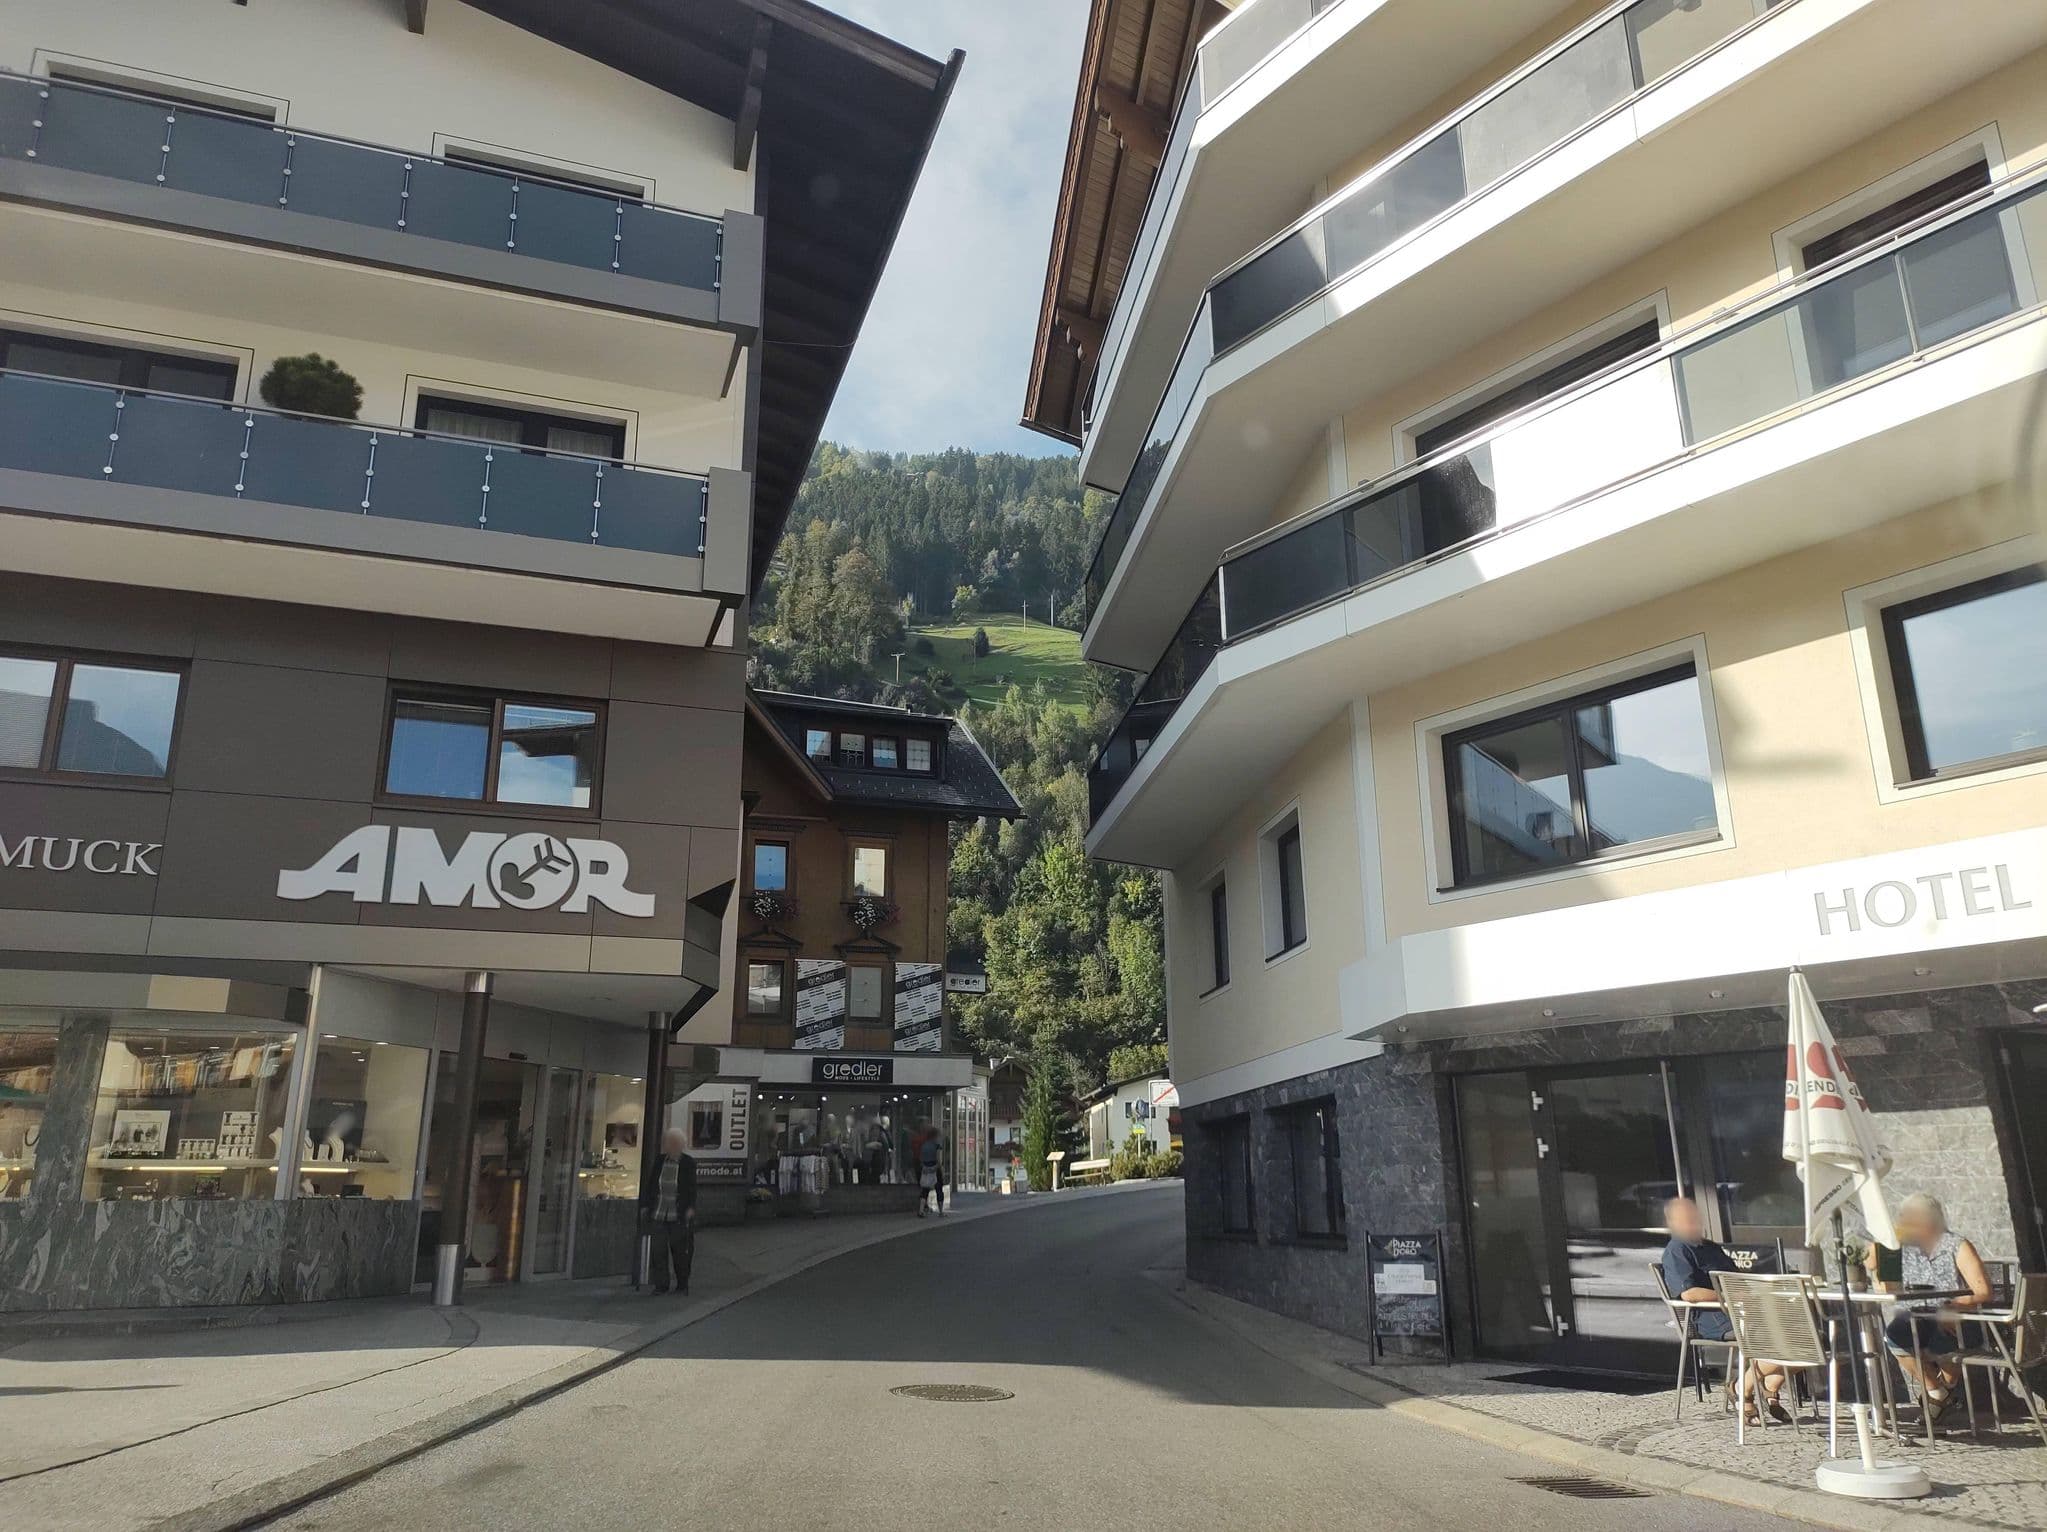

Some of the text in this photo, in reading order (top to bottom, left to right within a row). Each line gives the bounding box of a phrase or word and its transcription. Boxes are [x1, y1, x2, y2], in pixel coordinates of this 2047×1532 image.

[0, 834, 163, 876] MUCK
[276, 825, 656, 918] AMOR
[1814, 864, 2033, 936] HOTEL
[822, 1061, 883, 1079] gredler
[730, 1088, 748, 1151] OUTLET
[1392, 1238, 1422, 1249] PIAZZA
